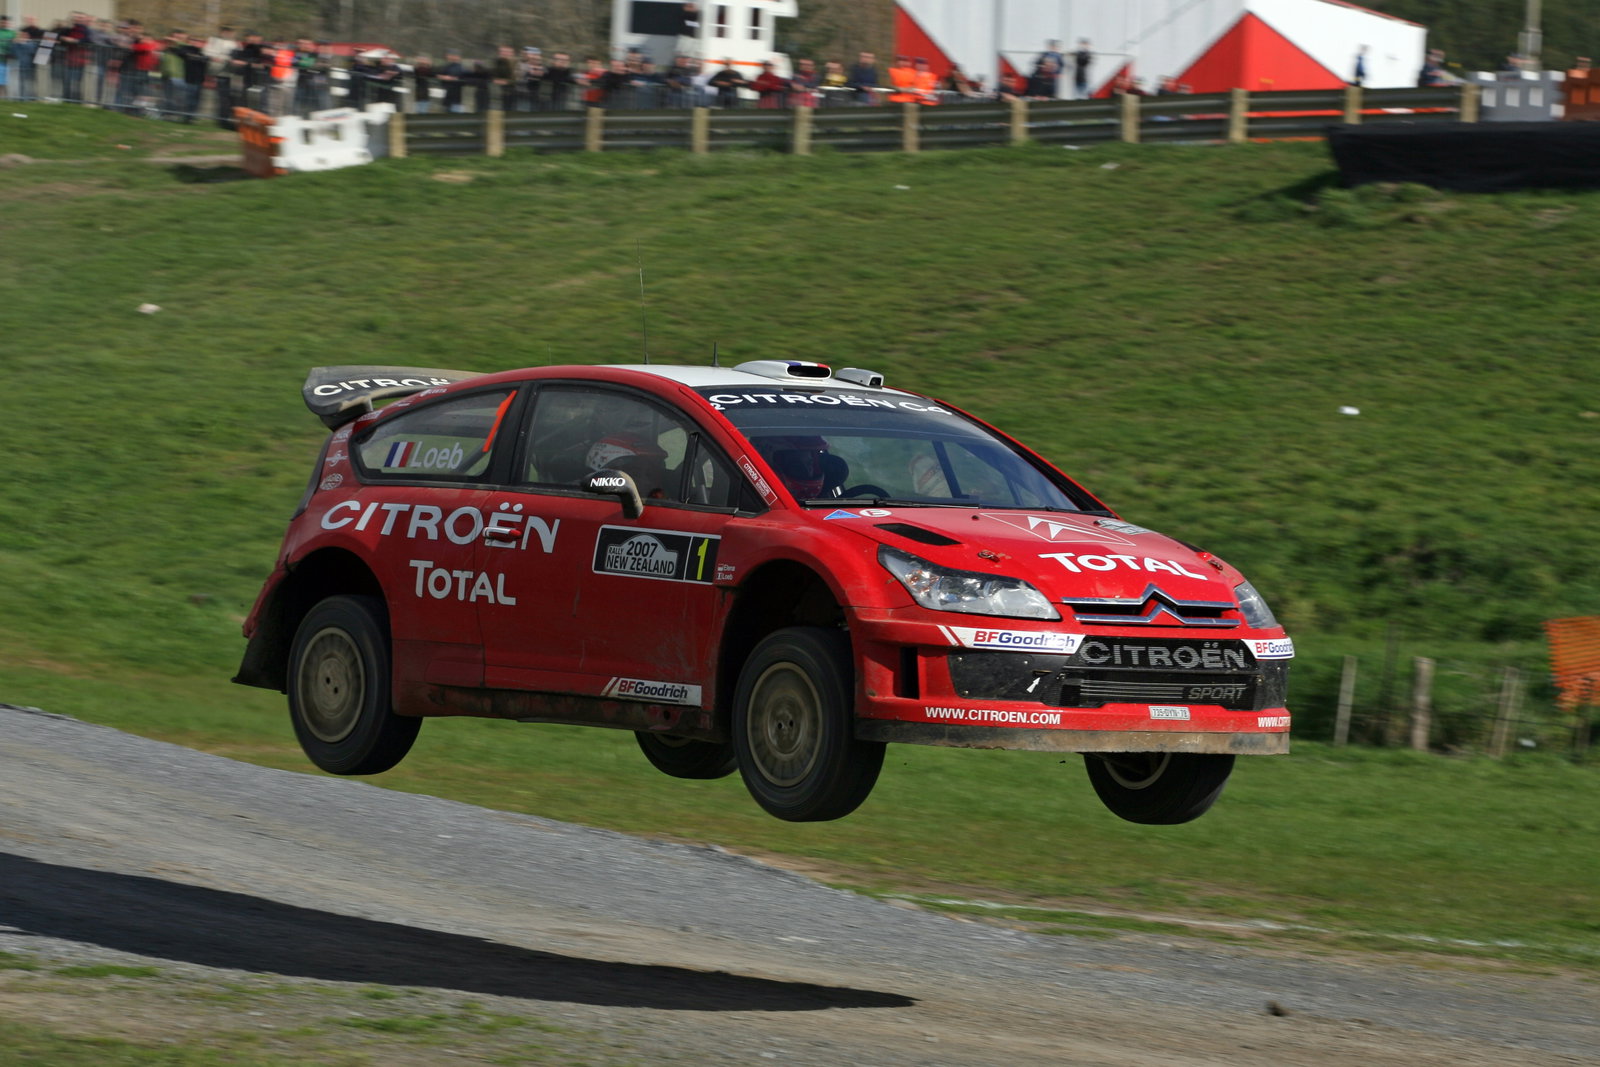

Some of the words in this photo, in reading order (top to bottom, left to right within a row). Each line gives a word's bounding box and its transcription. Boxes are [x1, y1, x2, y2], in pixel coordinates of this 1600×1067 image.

[709, 394, 897, 409] CITROËN
[410, 441, 464, 469] Loeb
[590, 477, 626, 488] NIKKO
[320, 500, 560, 553] CITROËN
[608, 547, 624, 555] RALLY
[626, 541, 659, 558] 2007
[696, 538, 709, 580] 1
[606, 554, 629, 570] NEW
[630, 557, 675, 574] ZEALAND
[1037, 553, 1208, 580] TOTAL
[409, 559, 516, 606] TOTAL
[1079, 641, 1247, 668] CITROËN
[618, 680, 688, 698] BFGoodrich
[1188, 687, 1247, 700] SPORT
[925, 707, 1061, 725] WWW.CITROEN.COM
